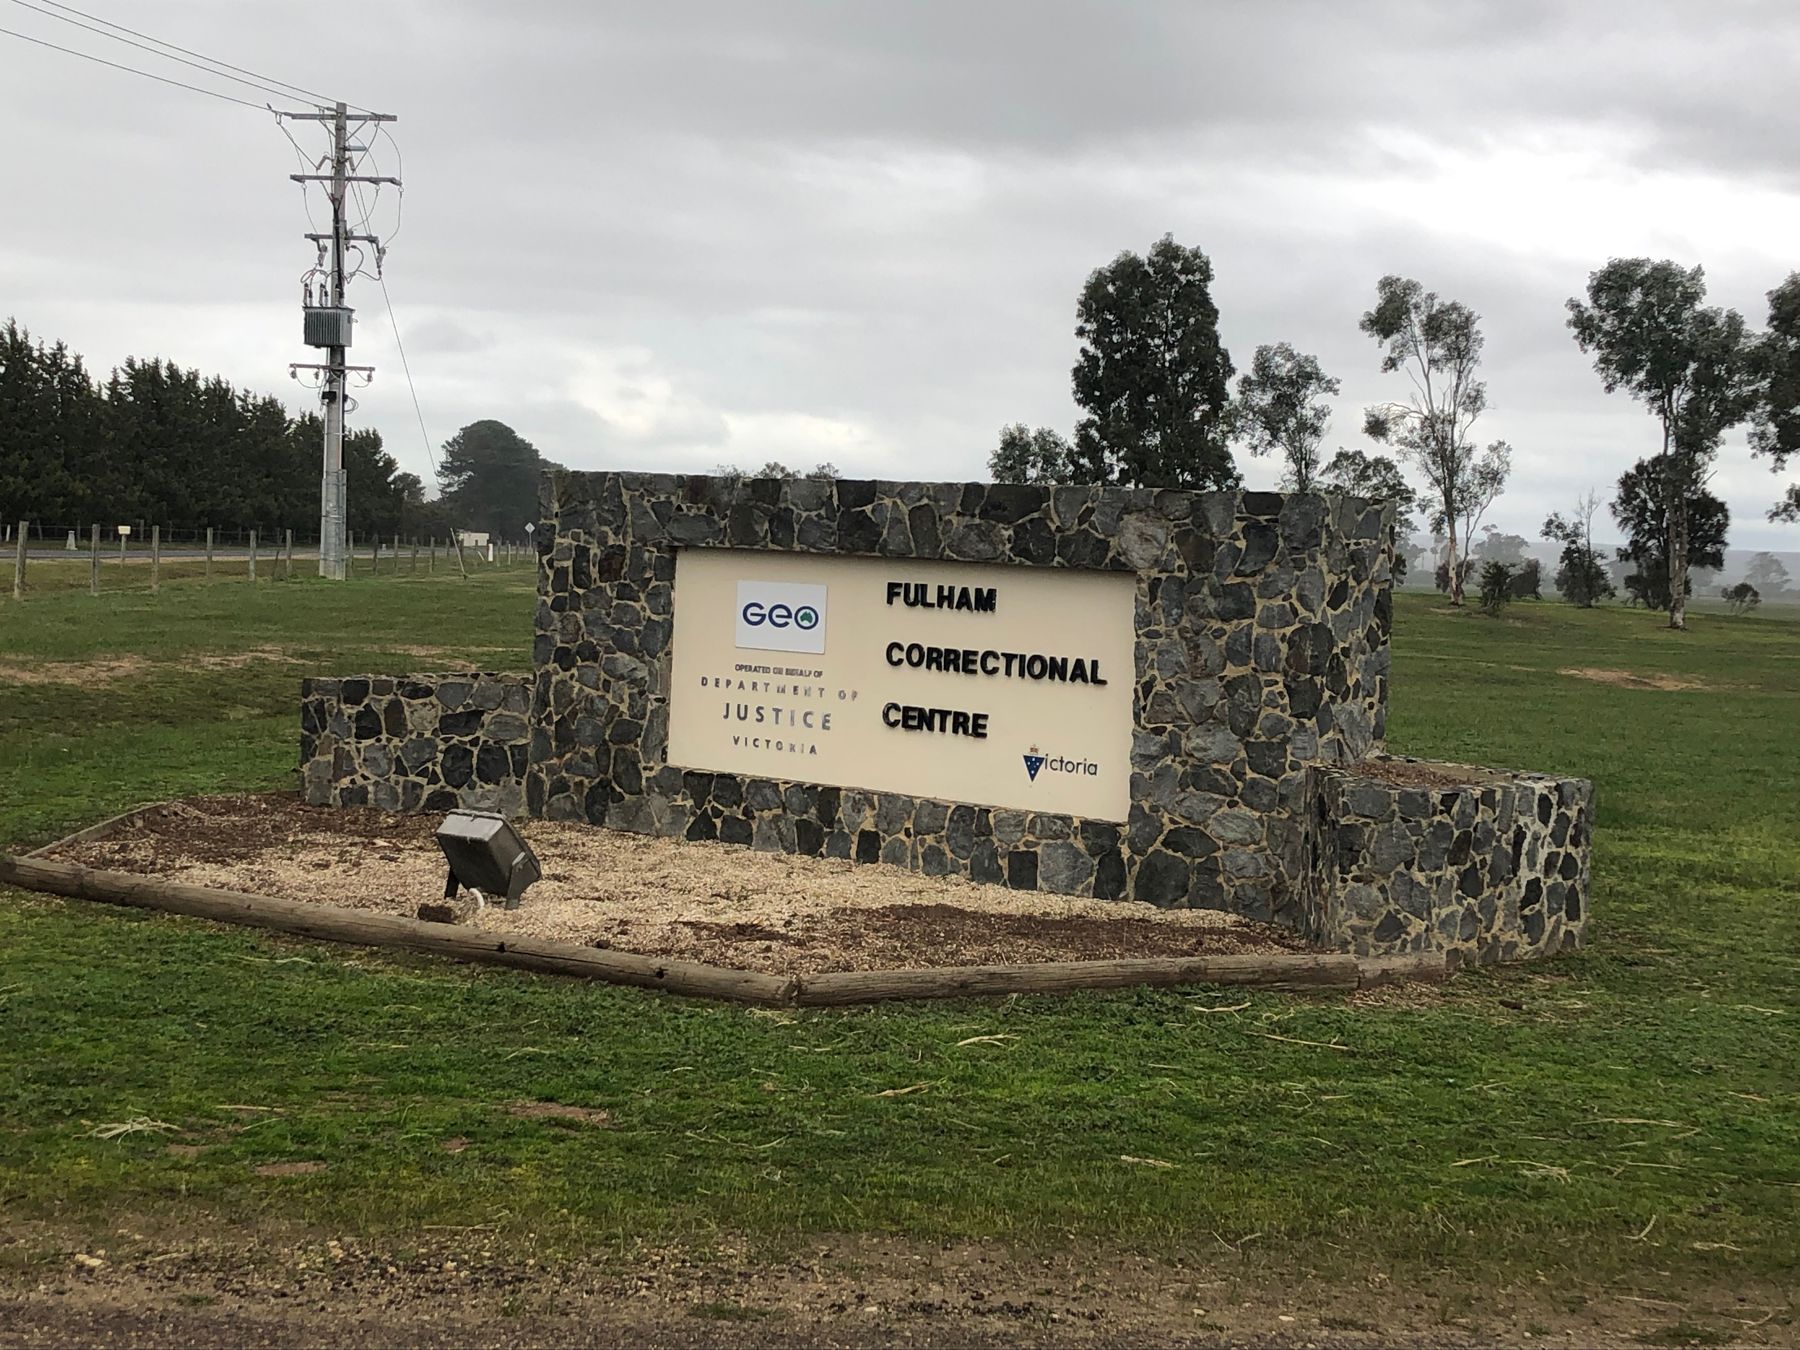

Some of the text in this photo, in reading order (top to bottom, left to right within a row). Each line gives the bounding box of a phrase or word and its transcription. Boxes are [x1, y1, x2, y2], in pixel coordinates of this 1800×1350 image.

[886, 581, 997, 613] FULHAM
[735, 664, 771, 674] OPERATED
[813, 670, 823, 678] OF
[886, 641, 1107, 685] CORRECTIONAL
[701, 676, 858, 701] DEPARTMENT OF
[723, 702, 832, 731] JUSTICE
[882, 702, 989, 738] CENTRE
[733, 735, 817, 755] VICTORIA
